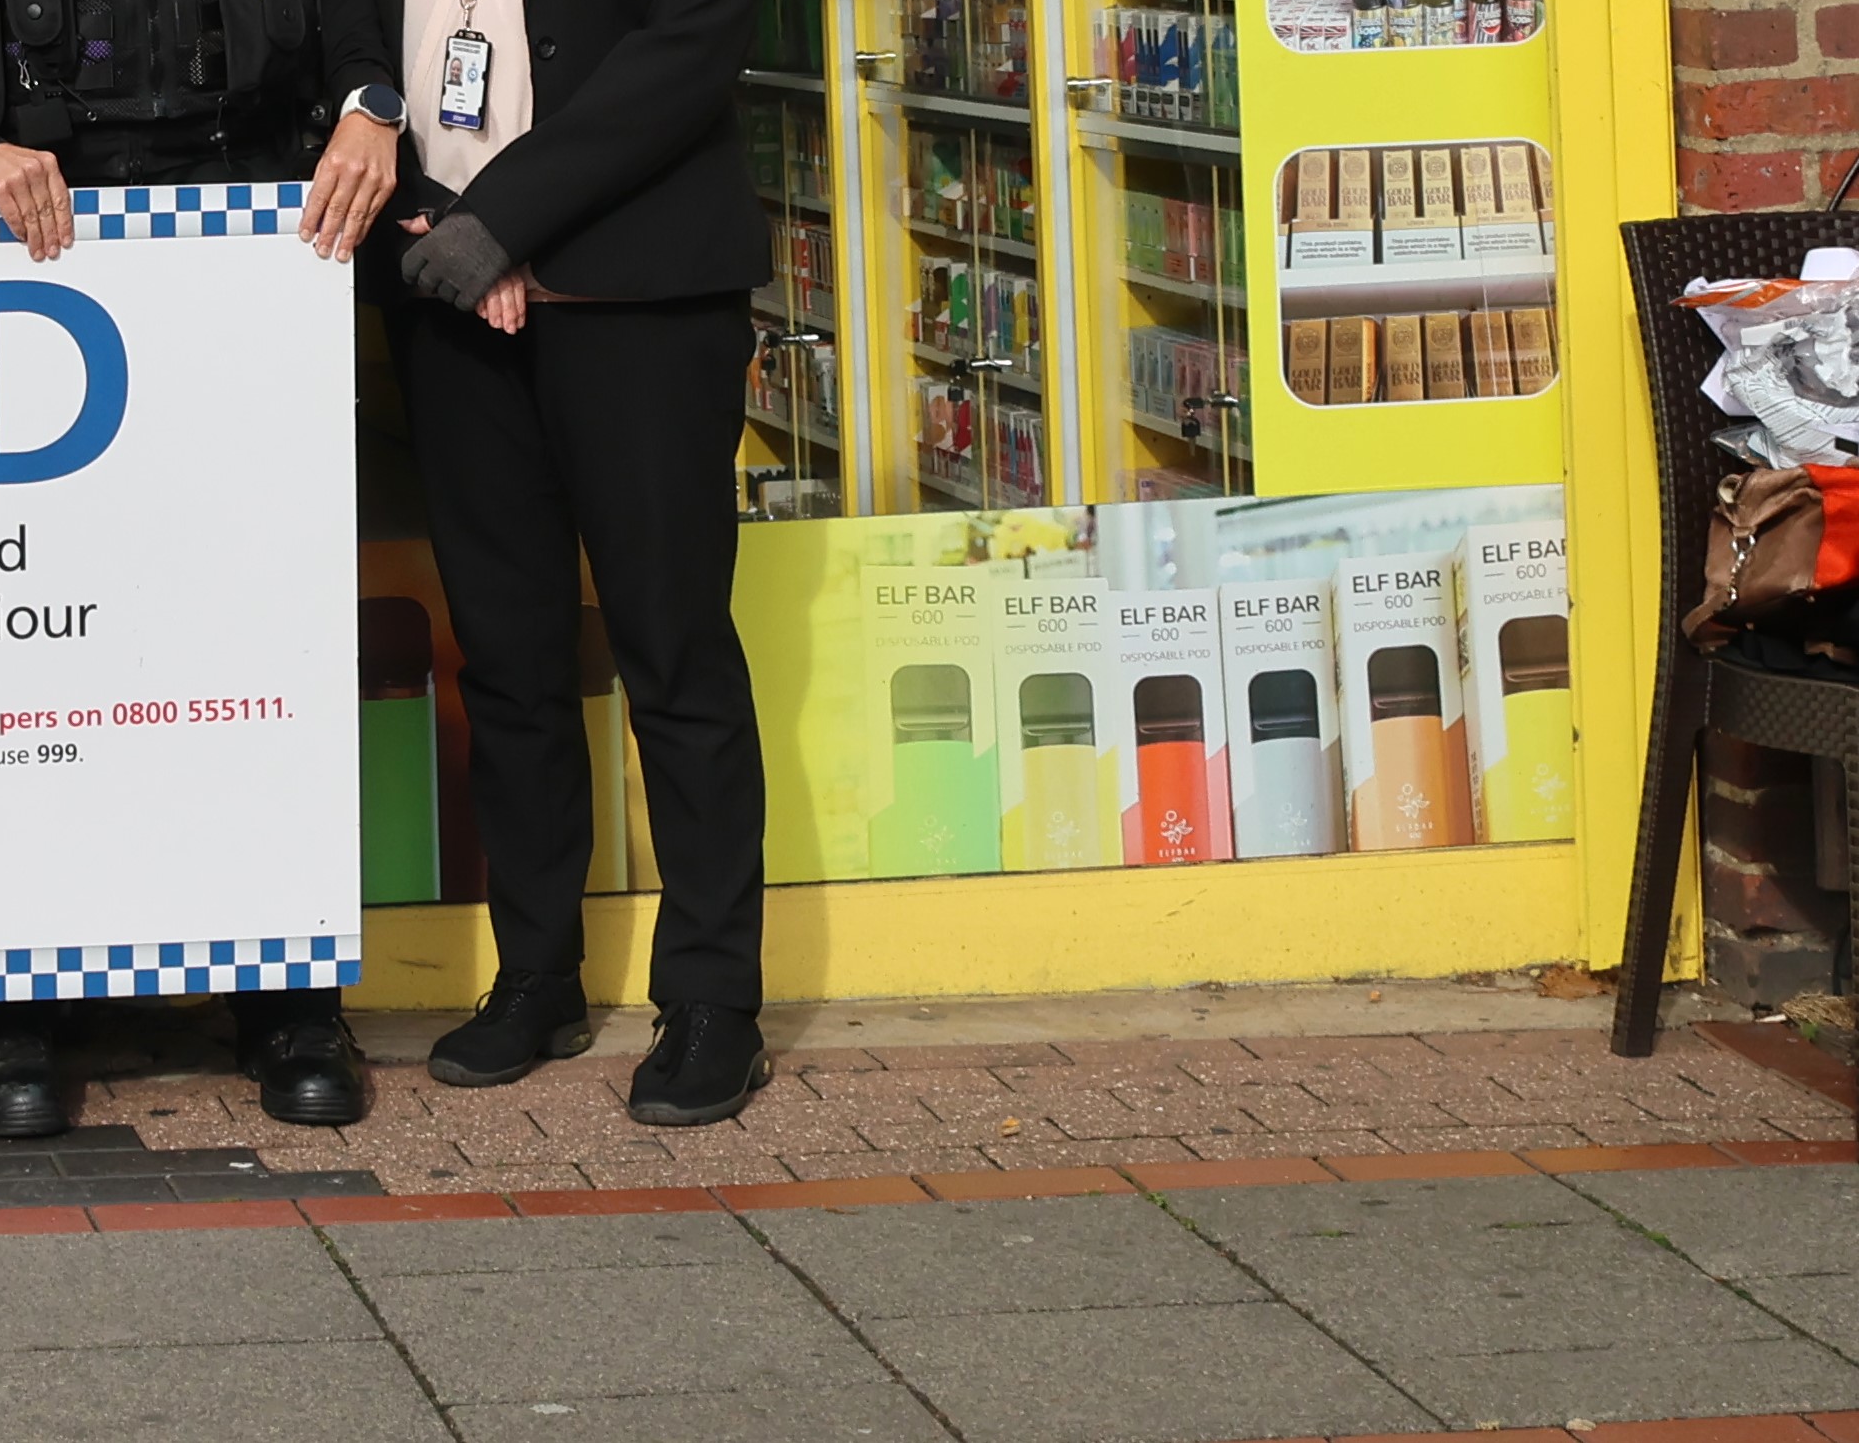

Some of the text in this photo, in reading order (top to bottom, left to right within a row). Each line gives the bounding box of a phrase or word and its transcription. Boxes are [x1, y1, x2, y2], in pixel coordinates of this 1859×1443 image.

[1352, 569, 1442, 594] ELF BAR
[876, 584, 976, 606] ELF BAR
[1233, 594, 1321, 618] ELF BAR
[1383, 595, 1414, 609] 600
[1120, 604, 1208, 627] ELF BAR
[1265, 619, 1294, 633] 600
[1151, 628, 1180, 642] 600
[1120, 649, 1212, 664] DISPOSABLE POD
[67, 707, 103, 729] on
[112, 701, 178, 726] 0800
[187, 697, 294, 724] 555111.
[37, 743, 84, 765] 999.
